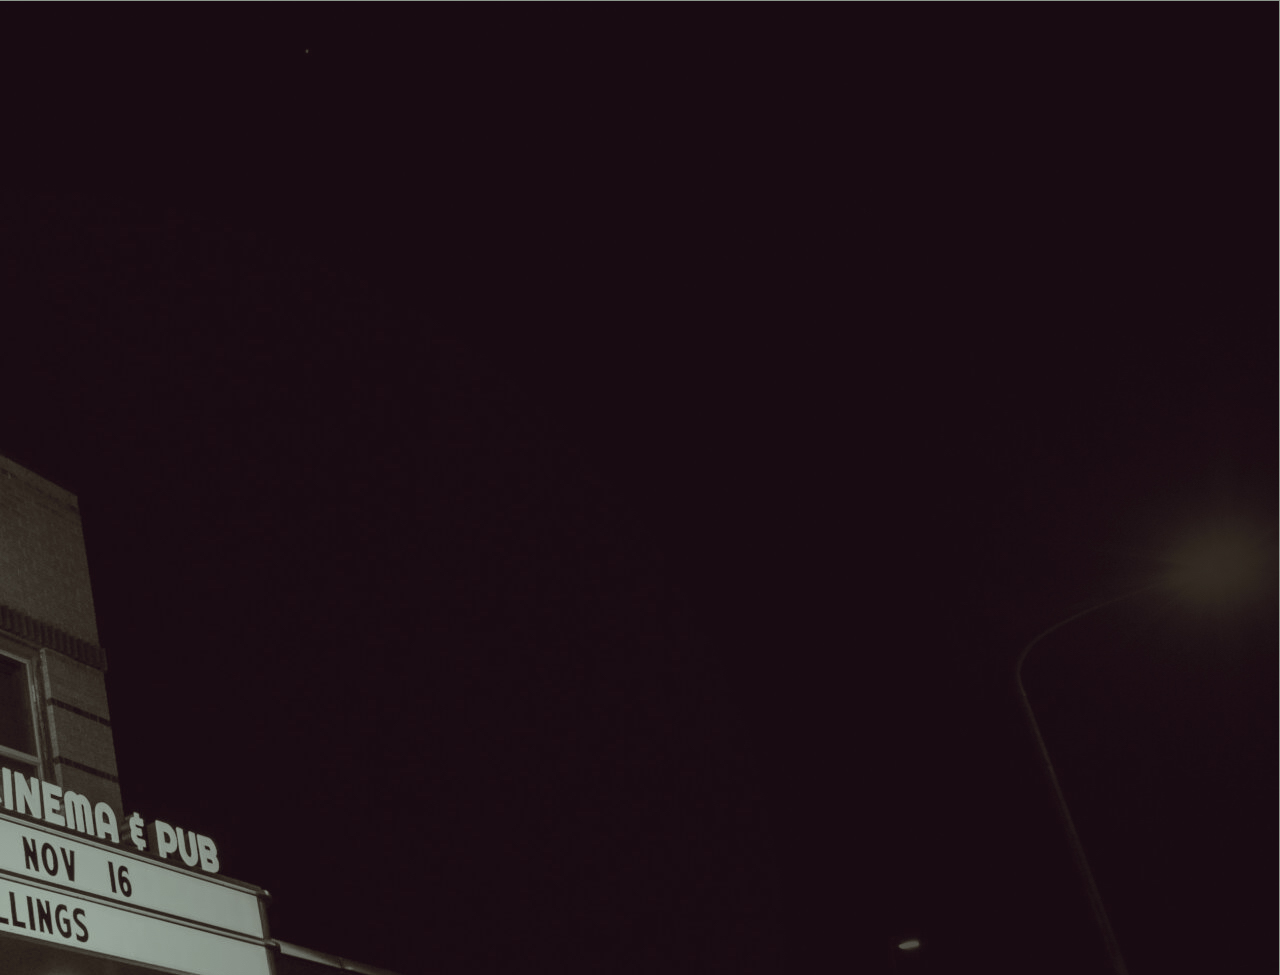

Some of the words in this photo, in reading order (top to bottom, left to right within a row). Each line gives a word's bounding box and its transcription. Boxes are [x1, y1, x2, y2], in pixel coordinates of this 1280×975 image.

[22, 835, 75, 881] NOV
[108, 861, 132, 897] 16
[154, 819, 221, 874] PUB
